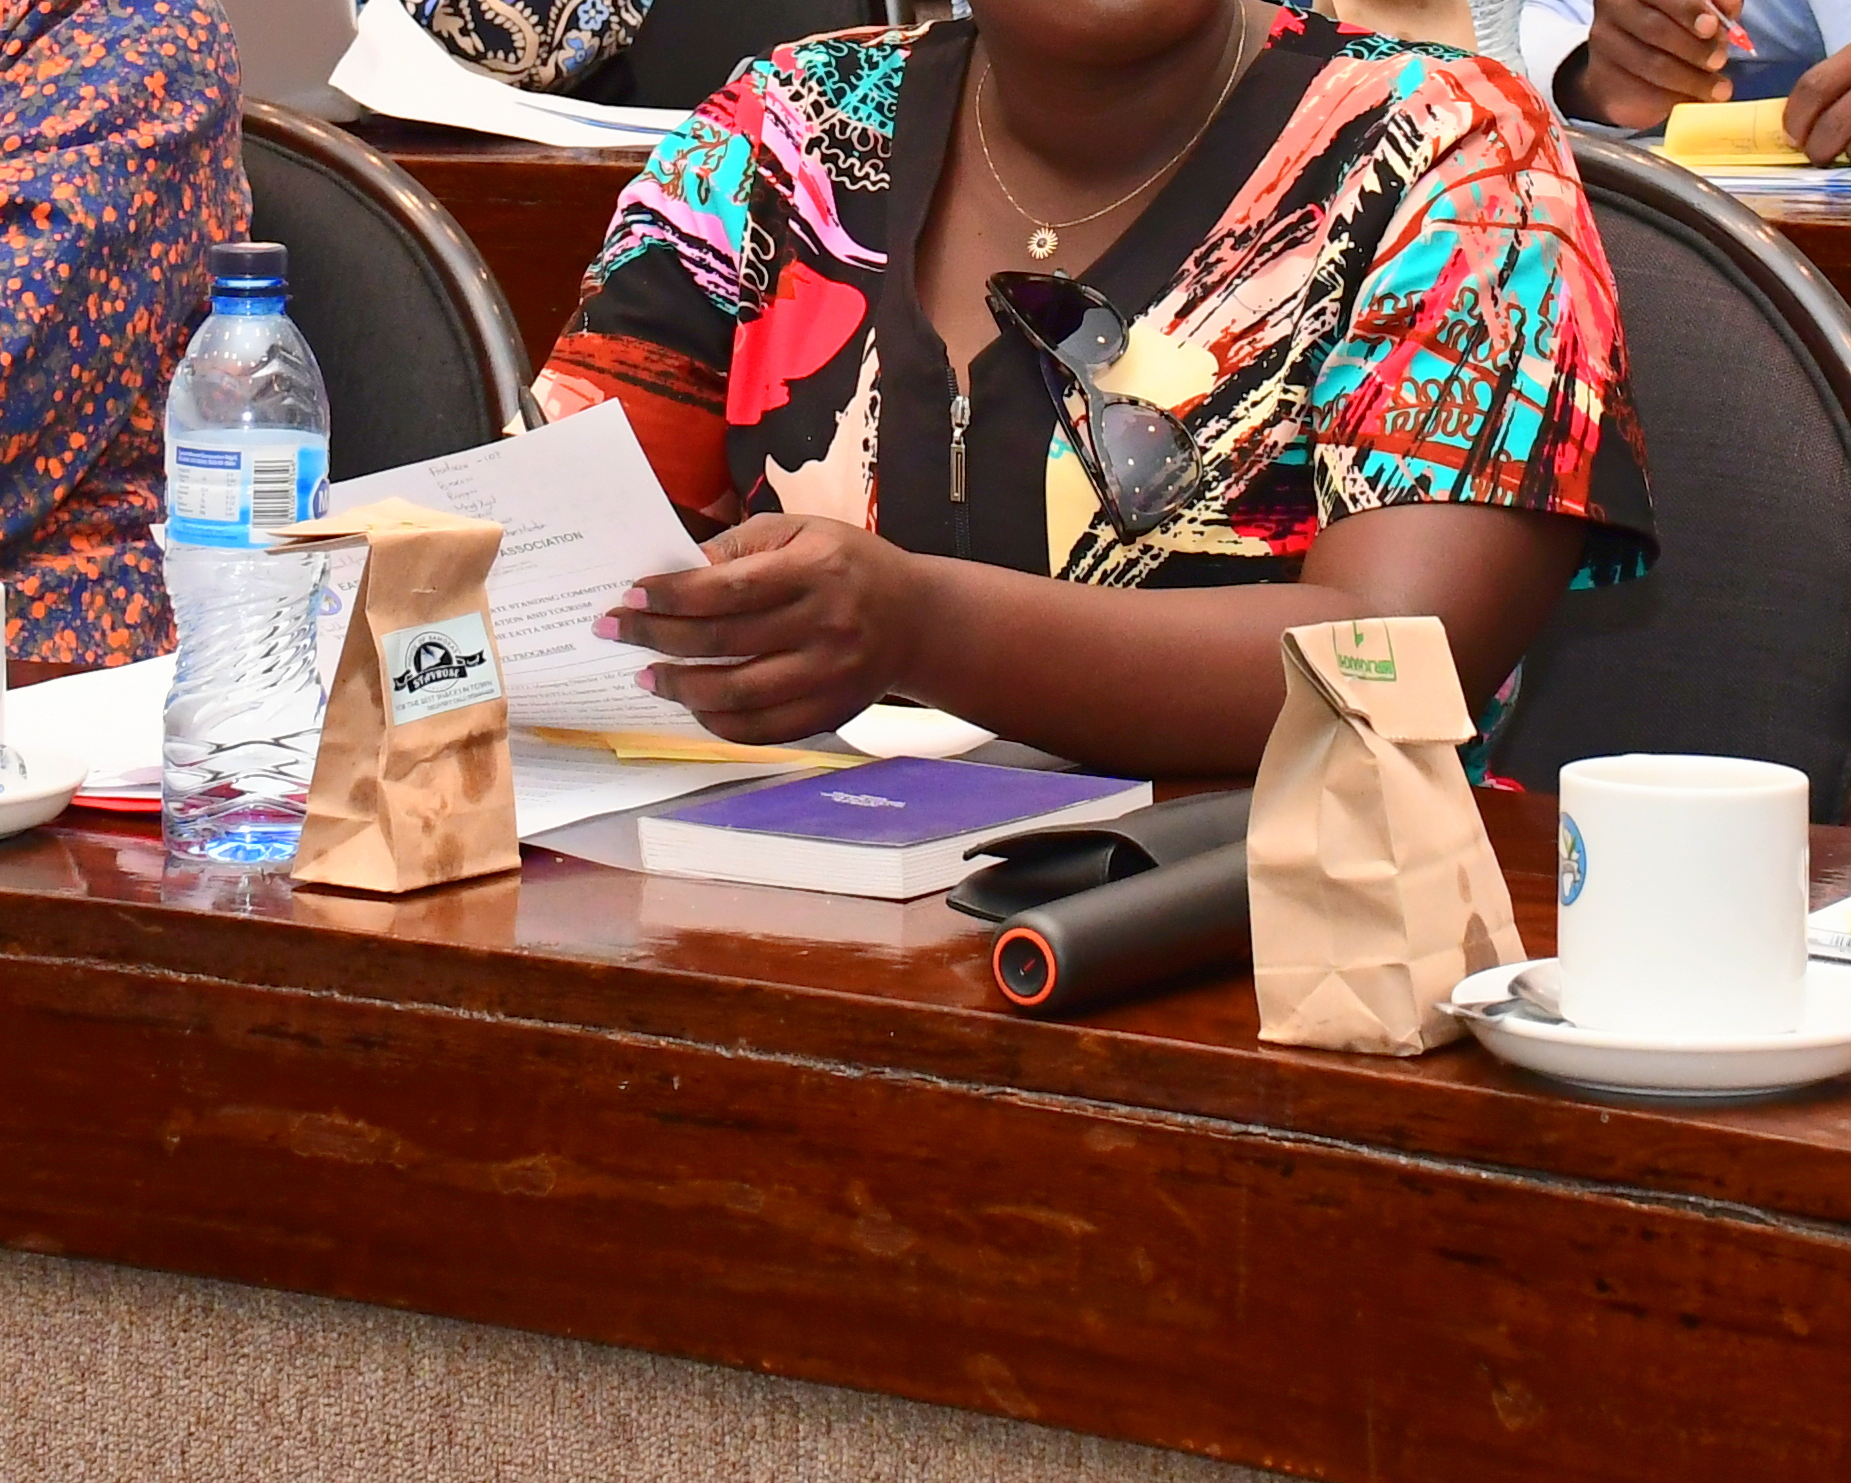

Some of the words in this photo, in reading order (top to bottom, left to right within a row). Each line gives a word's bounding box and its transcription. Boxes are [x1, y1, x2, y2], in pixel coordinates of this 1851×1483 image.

[500, 531, 584, 557] ASSOCIATION
[509, 594, 560, 610] STANDING
[560, 581, 618, 600] COMMITTEE
[526, 610, 548, 621] AND
[548, 601, 592, 618] TOURISM
